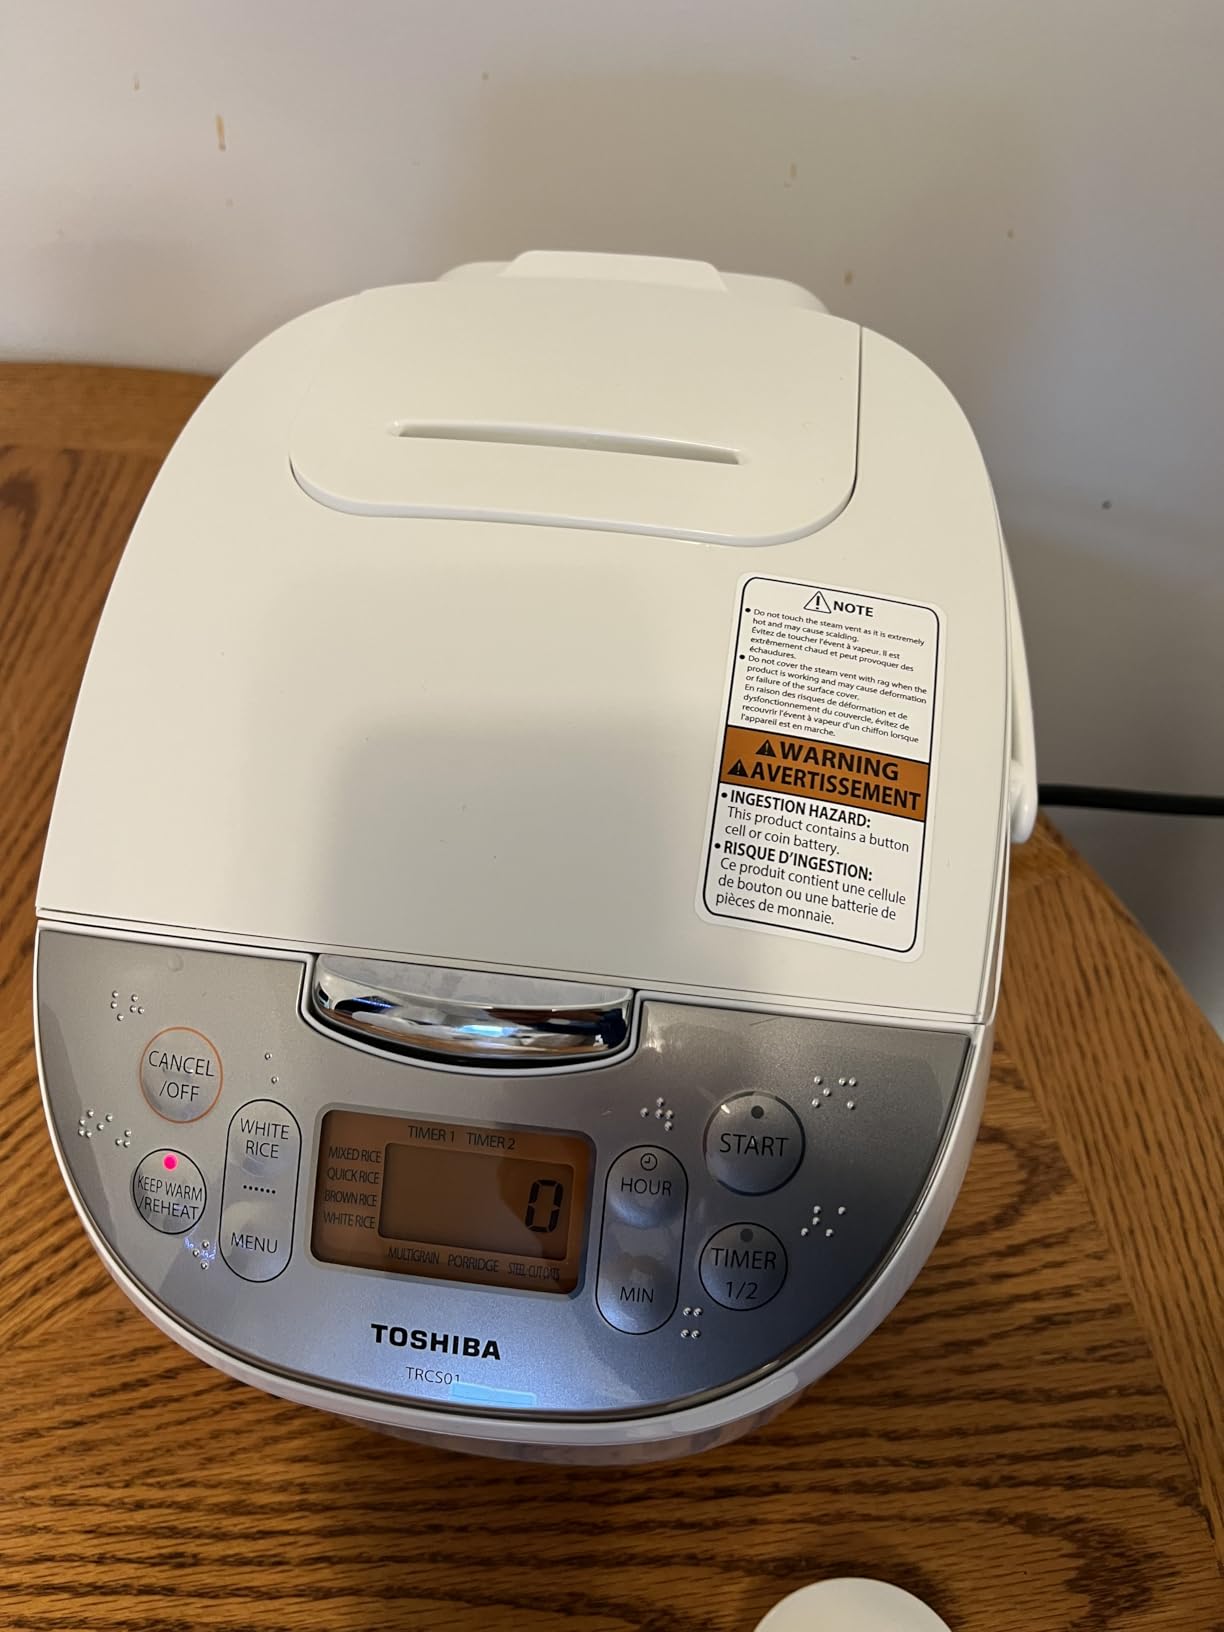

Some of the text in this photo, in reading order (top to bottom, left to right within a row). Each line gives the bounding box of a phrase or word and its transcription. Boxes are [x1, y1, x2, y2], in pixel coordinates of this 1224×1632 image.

[833, 600, 874, 617] NOTE
[751, 626, 775, 637] Évitez
[788, 633, 818, 644] toucher
[752, 617, 766, 626] hot
[784, 624, 801, 633] may
[802, 627, 824, 636] cause
[753, 608, 765, 616] Do
[781, 614, 804, 622] touch
[805, 617, 818, 625] the
[820, 621, 843, 630] steam
[844, 625, 862, 633] vent
[887, 634, 925, 647] extremely
[750, 637, 803, 651] extrêmement
[804, 646, 828, 655] chaud
[839, 653, 858, 661] peut
[858, 656, 899, 669] provoquer
[900, 664, 914, 672] des
[746, 666, 778, 676] product
[787, 672, 820, 684] working
[821, 678, 836, 686] and
[837, 681, 855, 691] may
[855, 685, 878, 694] cause
[879, 689, 927, 704] deformation
[748, 655, 760, 663] Do
[776, 661, 798, 669] cover
[800, 664, 813, 672] the
[814, 667, 838, 676] steam
[839, 672, 857, 680] vent
[877, 679, 890, 688] rag
[891, 682, 913, 691] when
[914, 686, 927, 694] the
[756, 675, 781, 686] failure
[792, 682, 805, 690] the
[806, 686, 835, 696] surface
[743, 694, 820, 713] dysfonctionnement
[821, 707, 833, 715] du
[875, 718, 898, 729] évitez
[900, 723, 910, 731] de
[744, 683, 755, 691] En
[756, 687, 780, 696] raison
[782, 690, 796, 698] des
[797, 693, 825, 704] risques
[826, 698, 837, 706] de
[838, 700, 887, 716] déformation
[897, 712, 908, 720] de
[742, 705, 778, 715] recouvrir
[807, 714, 812, 722] à
[813, 717, 841, 727] vapeur
[861, 725, 889, 737] chiffon
[890, 730, 919, 743] lorsque
[780, 741, 899, 781] WARNING
[750, 761, 921, 811] AVERTISSEMENT
[730, 789, 871, 828] INGESTION HAZARD:
[725, 824, 840, 856] cell or coin battery.
[727, 805, 909, 853] This product contains a button
[724, 840, 776, 862] RISQUE
[720, 857, 906, 905] Ce produit contient une cellule
[715, 892, 834, 925] pièces de monnaie.
[718, 874, 896, 920] de bouton ou une batterie de
[148, 1050, 215, 1077] CANCEL
[159, 1081, 200, 1102] /OFF
[240, 1117, 290, 1140] WHITE
[408, 1125, 455, 1143] TIMER 1
[245, 1140, 279, 1159] RICE
[465, 1132, 516, 1150] TIMER 2
[719, 1133, 789, 1157] START
[328, 1146, 382, 1163] MIXED RICE
[327, 1166, 379, 1185] QUICK RICE
[620, 1178, 672, 1197] HOUR
[137, 1175, 203, 1201] KEEP WARM
[324, 1189, 377, 1207] BROWN RICE
[138, 1196, 199, 1221] /REHEAT
[524, 1179, 564, 1233] 0
[323, 1211, 376, 1229] WHITE RICE
[231, 1232, 278, 1254] MENU
[388, 1247, 499, 1273] MULTIGRAIN PORRIDGE
[711, 1247, 777, 1270] TIMER
[619, 1286, 654, 1303] MIN
[726, 1281, 758, 1300] 1/2
[370, 1323, 501, 1360] TOSHIBA
[405, 1366, 460, 1385] TRCS01
